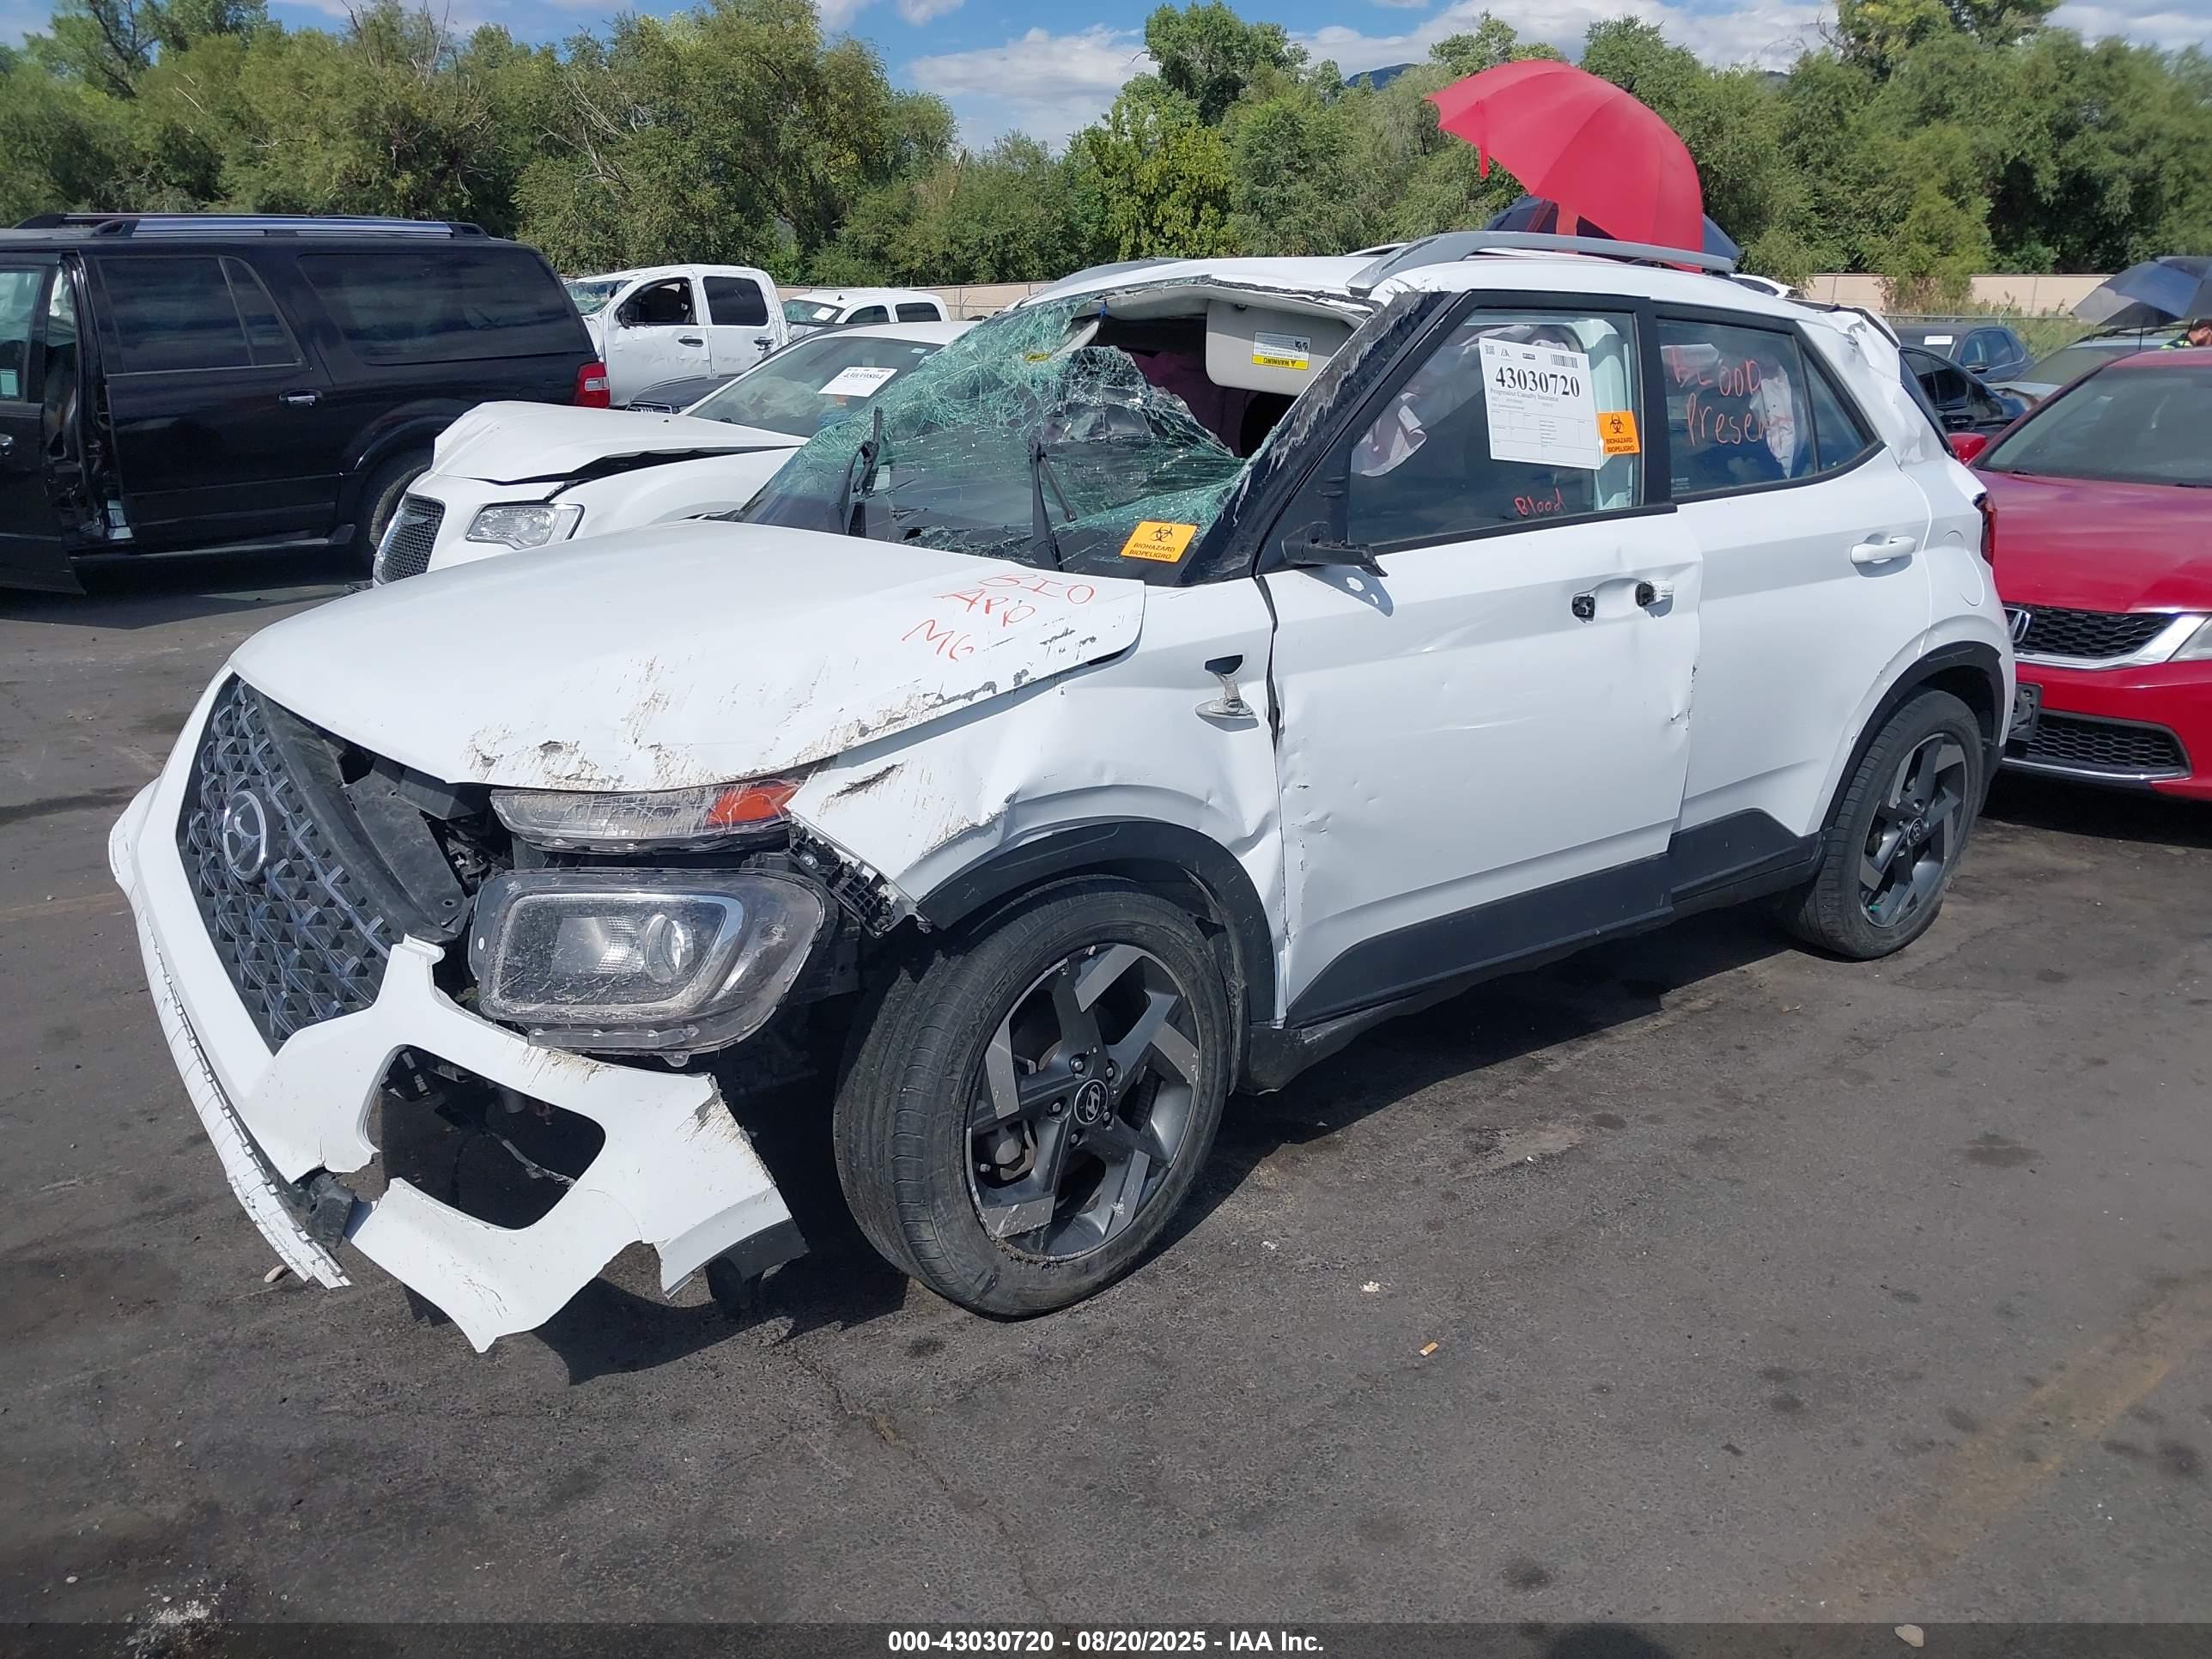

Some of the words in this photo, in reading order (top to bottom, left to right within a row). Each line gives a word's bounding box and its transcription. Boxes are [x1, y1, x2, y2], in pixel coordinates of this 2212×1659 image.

[1263, 357, 1290, 367] WARNING
[1496, 367, 1580, 398] 43030720
[1514, 488, 1566, 516] Blood
[1128, 550, 1171, 559] BIOPELIGRO
[1133, 542, 1176, 552] BIOHAZARD
[978, 574, 1095, 605] BIO
